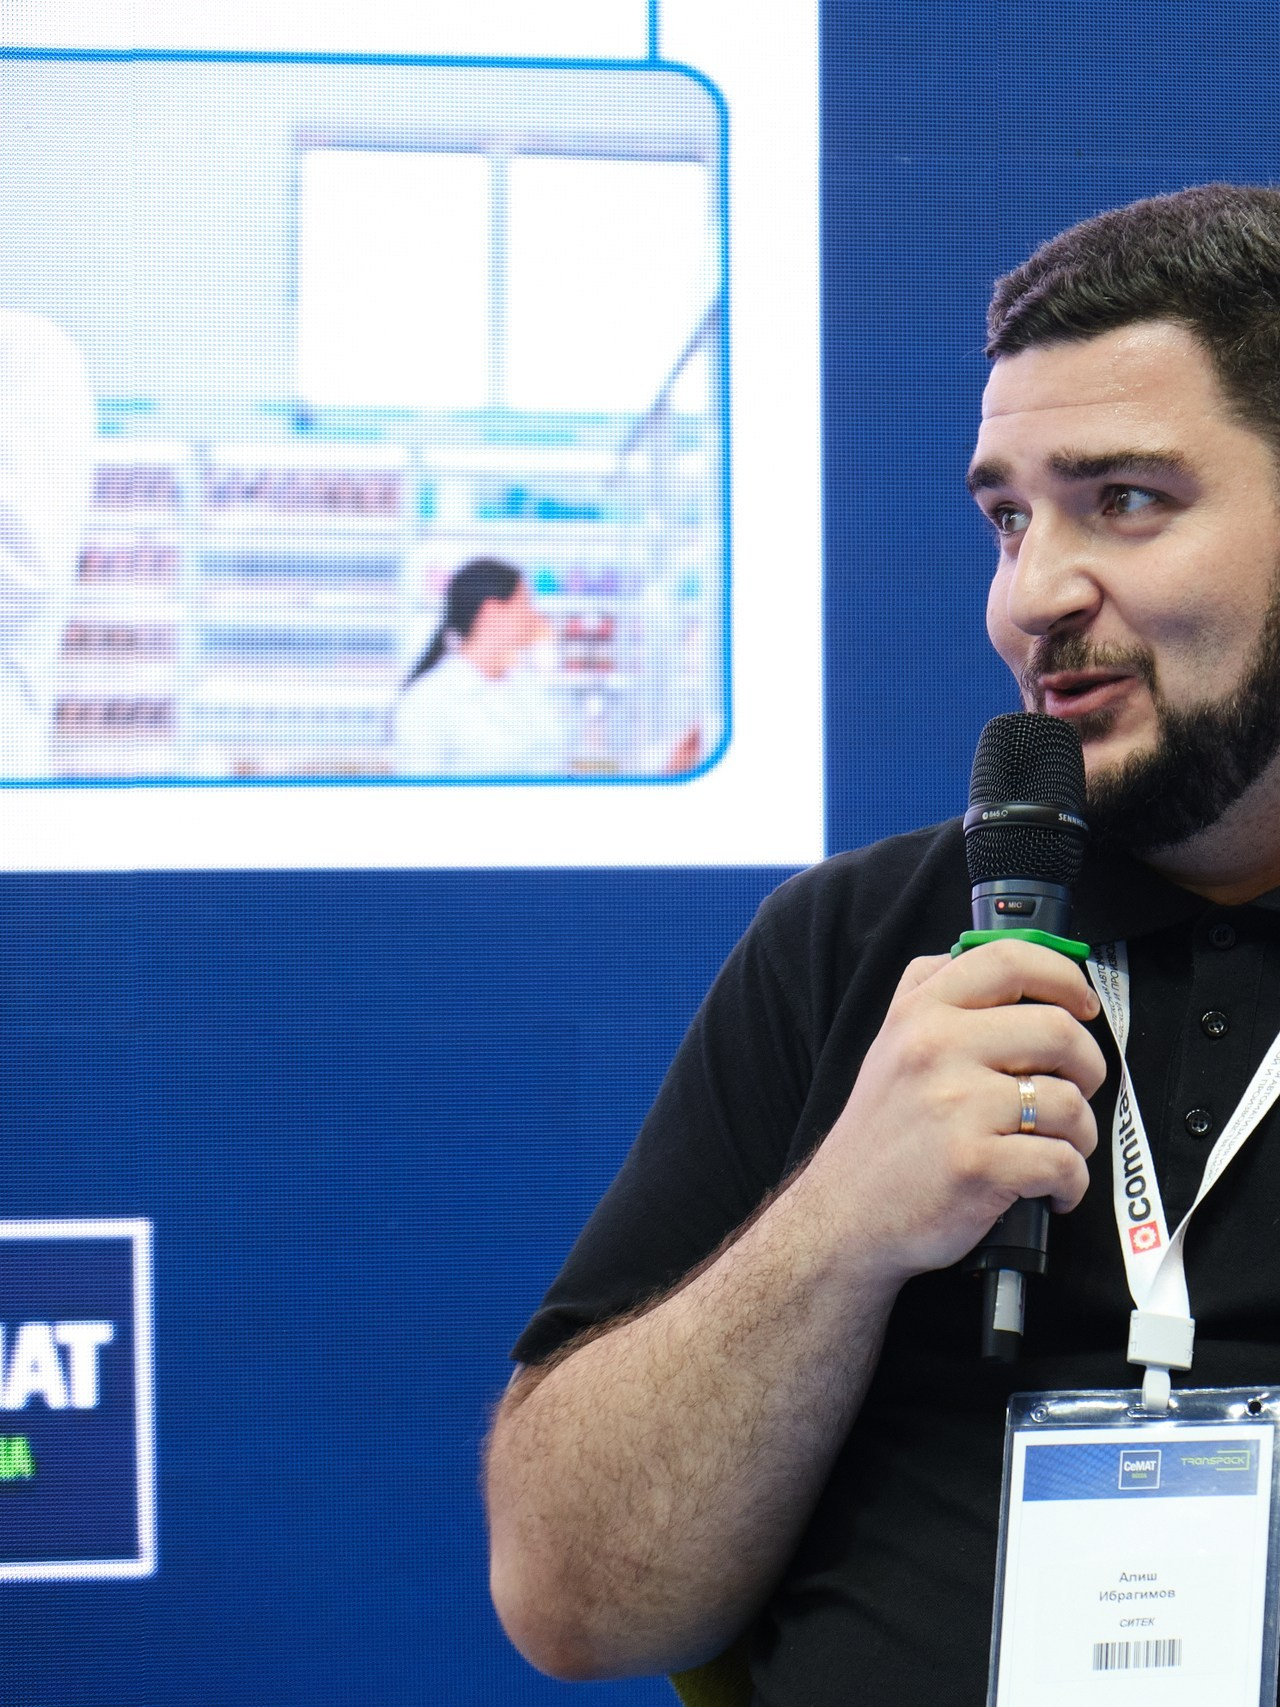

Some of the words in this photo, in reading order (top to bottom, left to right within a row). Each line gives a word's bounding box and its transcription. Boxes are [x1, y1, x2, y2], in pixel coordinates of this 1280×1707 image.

[1008, 901, 1022, 909] MIC
[1123, 1460, 1157, 1472] CeMAT
[1119, 1572, 1157, 1583] Алиш
[1099, 1589, 1176, 1603] Ибрагимов
[1119, 1617, 1155, 1628] СИТЕК
